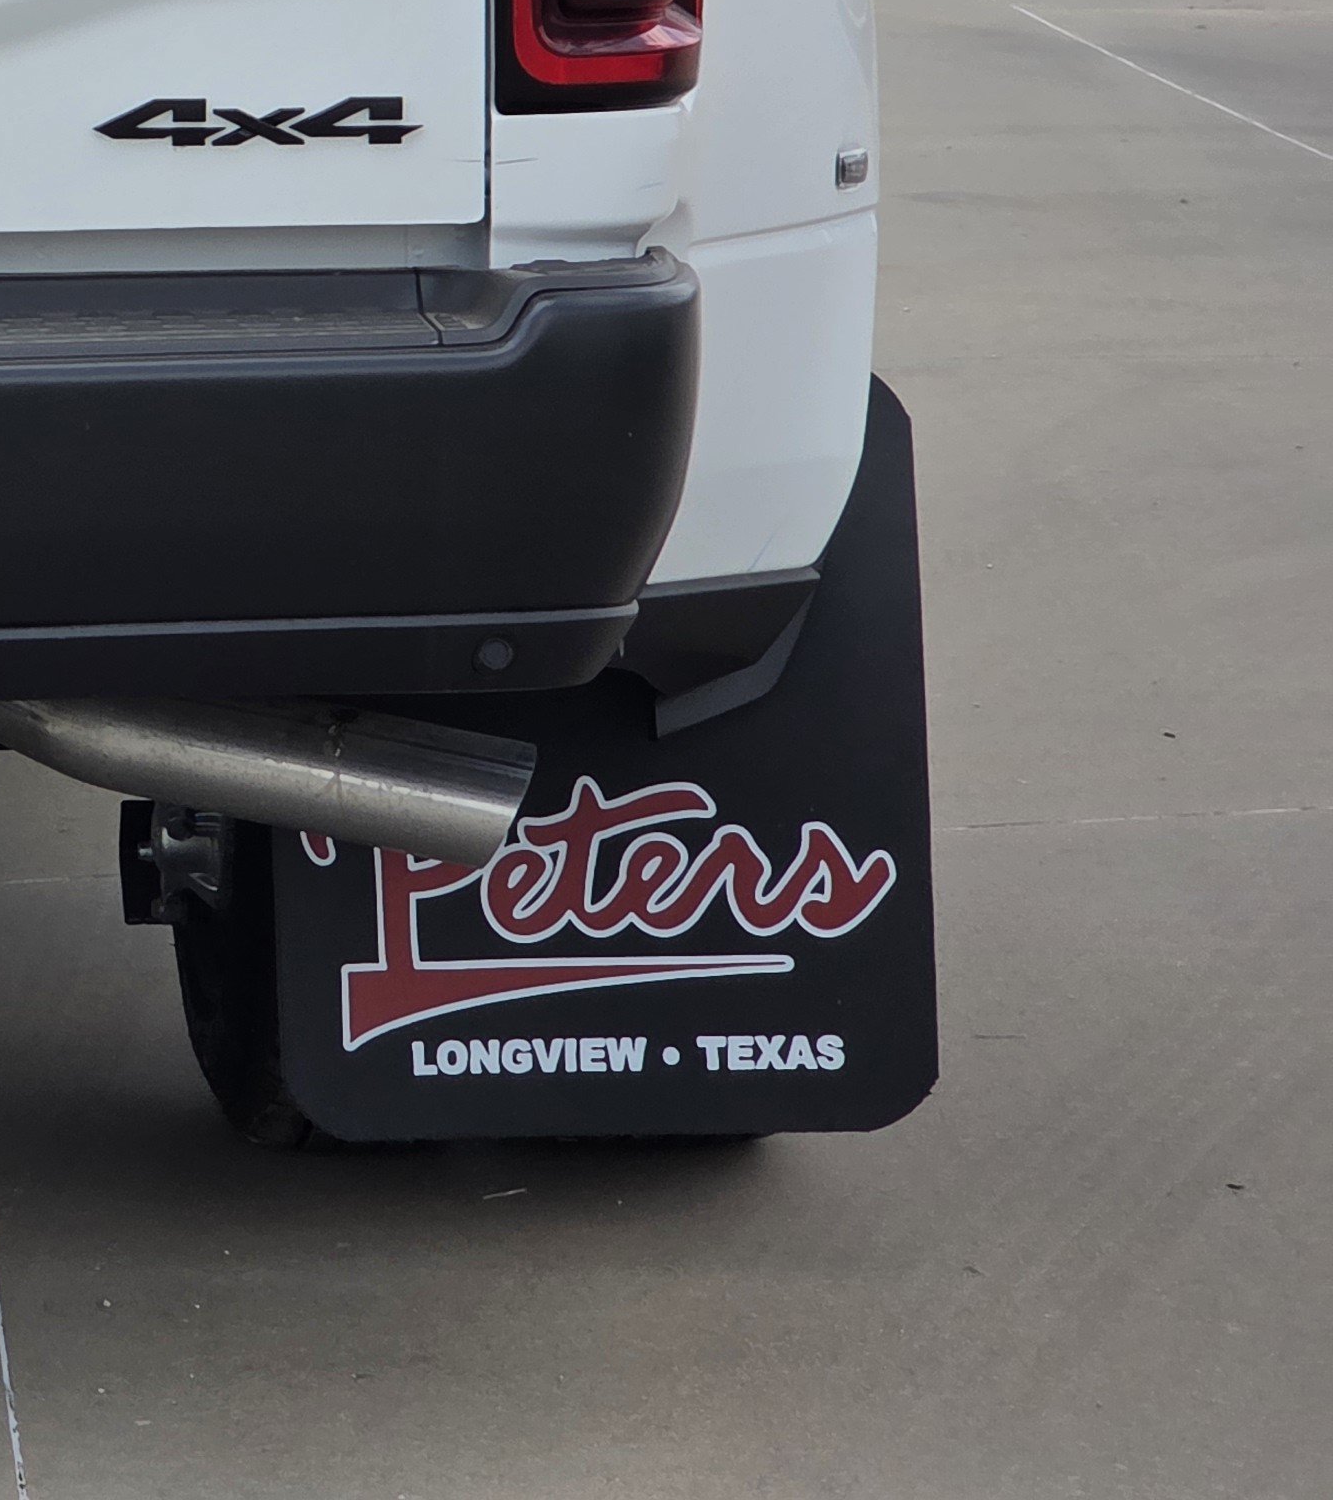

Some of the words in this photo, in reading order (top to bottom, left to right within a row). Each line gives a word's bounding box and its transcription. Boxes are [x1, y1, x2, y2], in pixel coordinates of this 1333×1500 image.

[93, 96, 423, 146] 4x4
[412, 1036, 647, 1077] LONGVIEW
[696, 1034, 845, 1071] TEXAS
